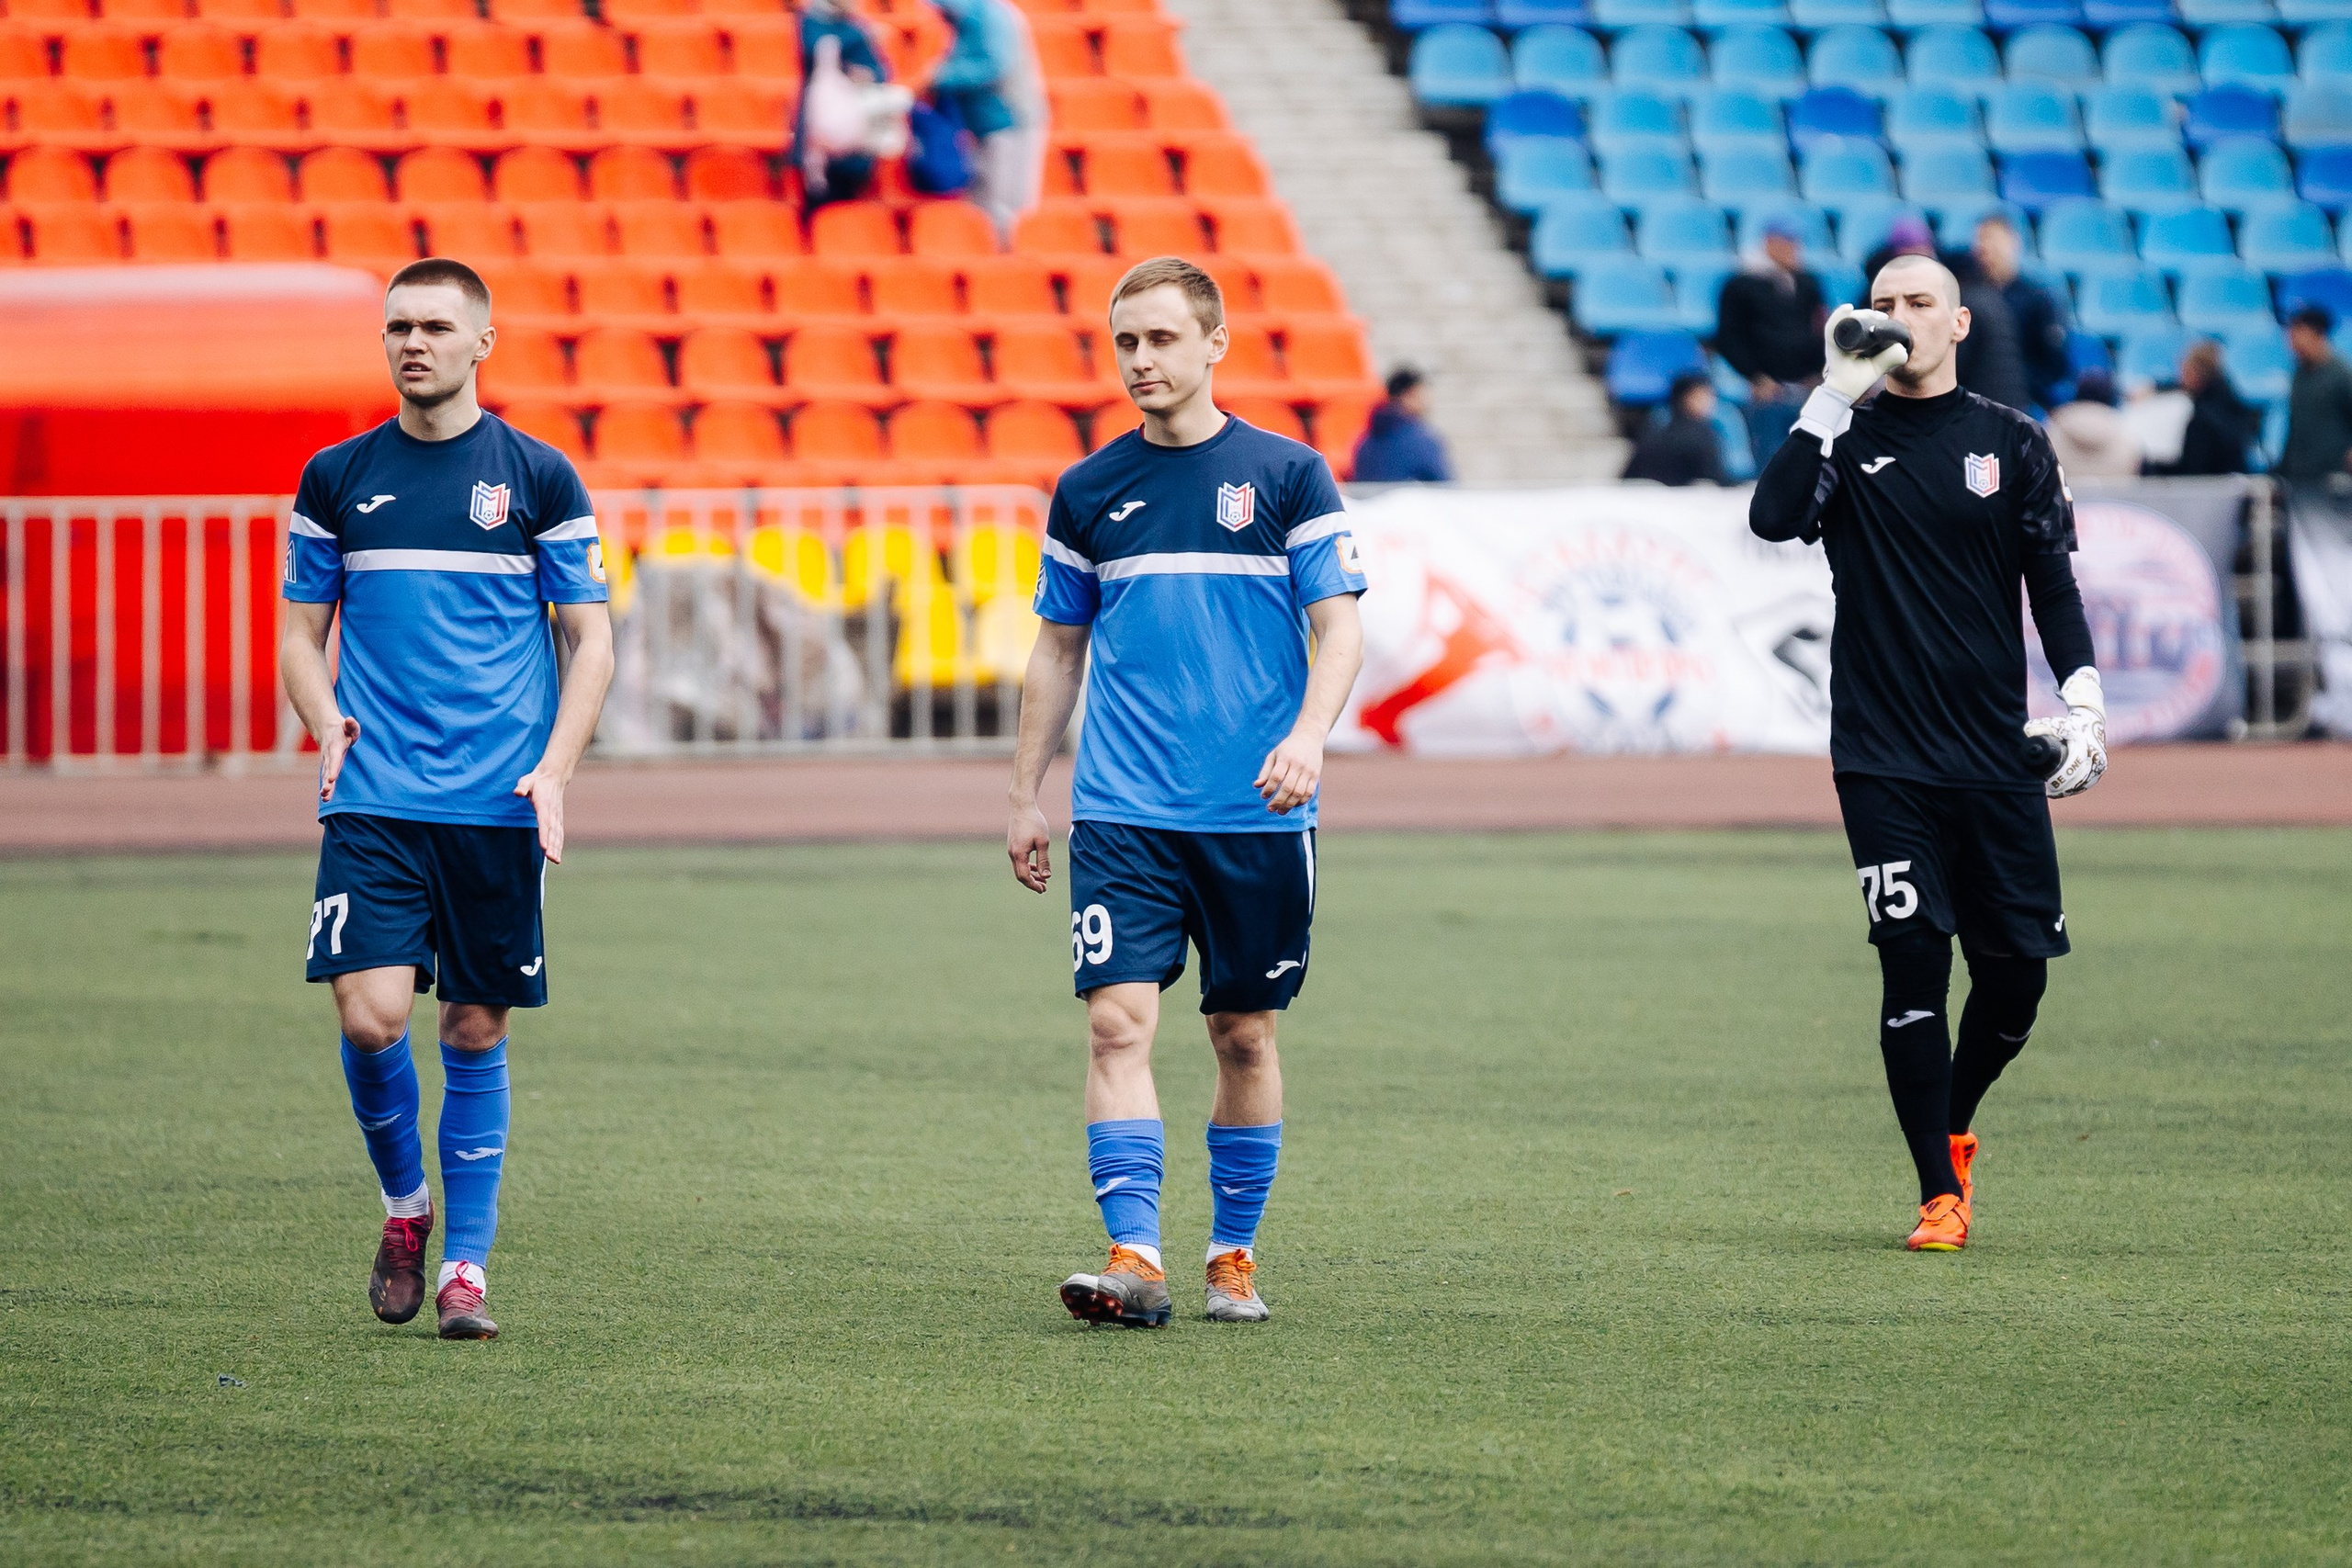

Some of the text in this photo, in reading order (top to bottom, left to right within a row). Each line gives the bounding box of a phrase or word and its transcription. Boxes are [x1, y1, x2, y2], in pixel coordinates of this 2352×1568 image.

[2052, 756, 2083, 789] BE ONE
[1857, 860, 1918, 922] 75
[306, 893, 348, 961] 77
[1071, 904, 1114, 973] 69
